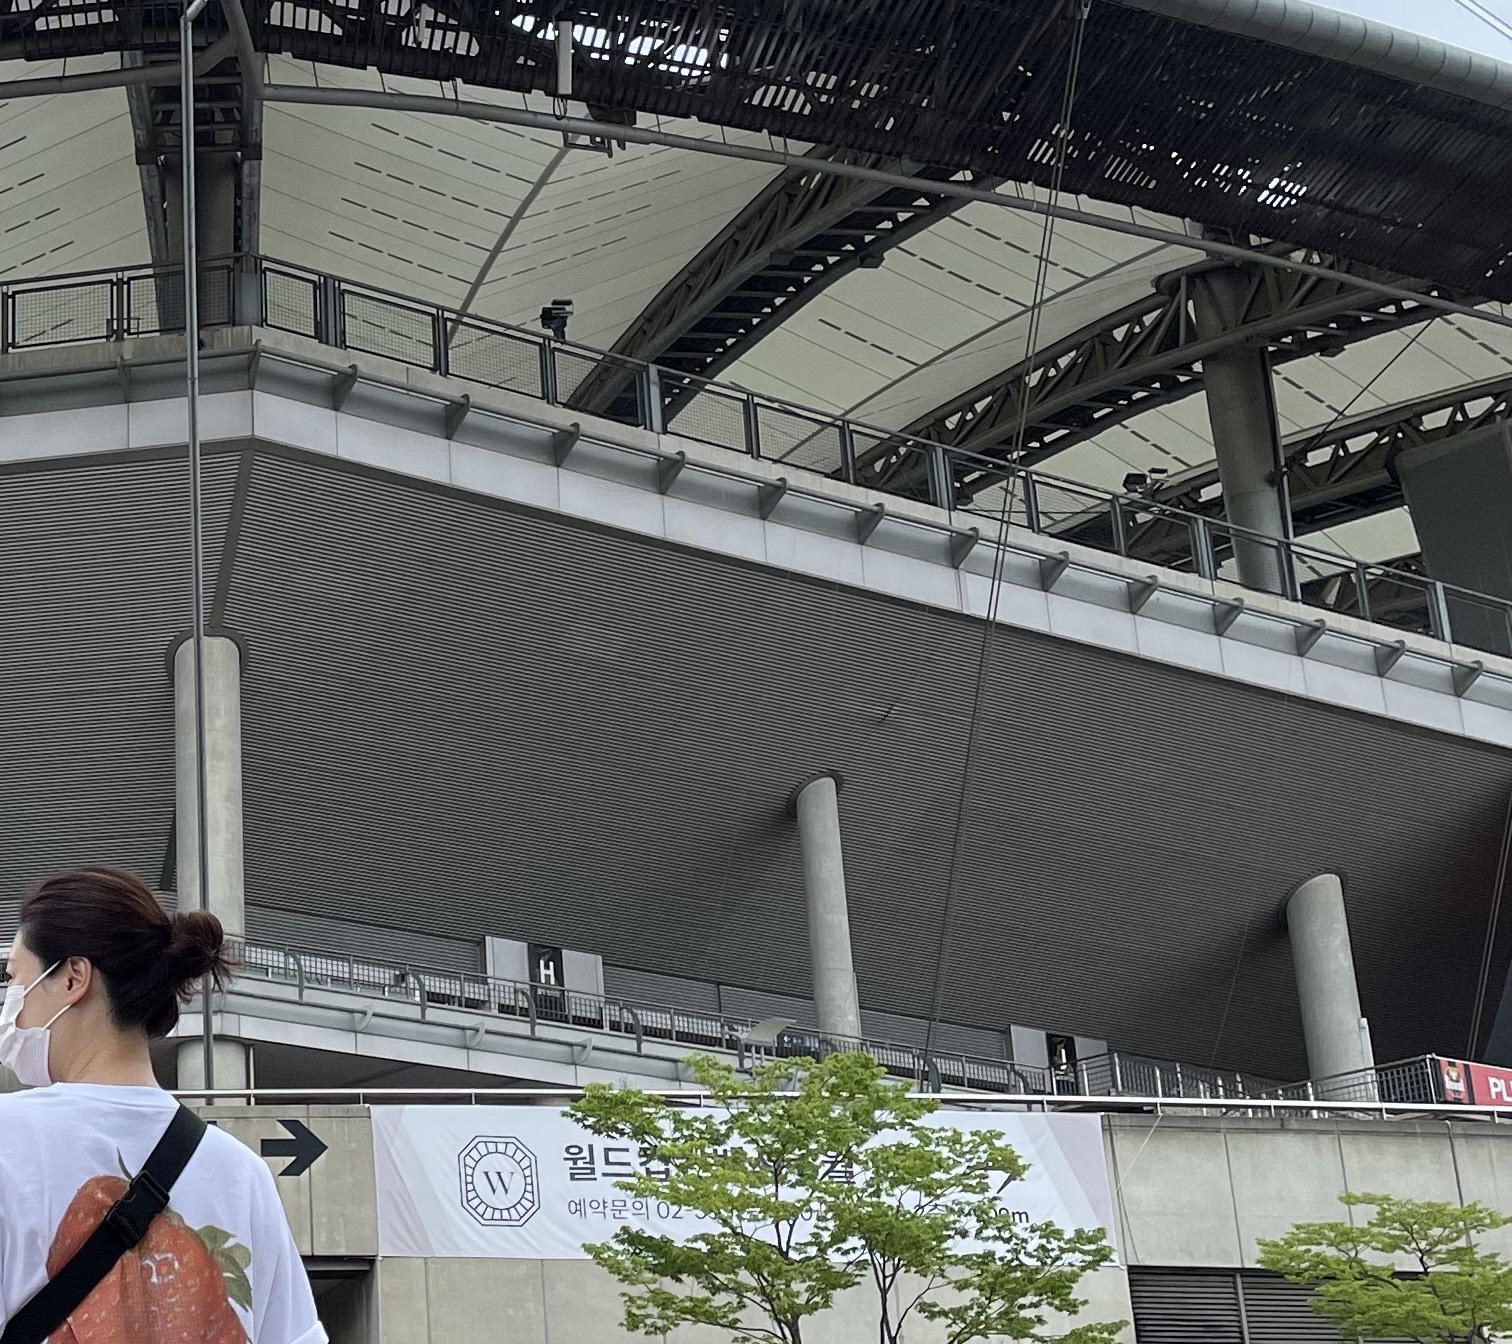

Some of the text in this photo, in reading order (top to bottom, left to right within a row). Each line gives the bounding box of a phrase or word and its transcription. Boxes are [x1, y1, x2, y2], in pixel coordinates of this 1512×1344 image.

[539, 959, 556, 986] H
[1487, 1075, 1512, 1102] PL
[482, 1170, 515, 1196] W
[568, 1197, 650, 1220] 예약문의
